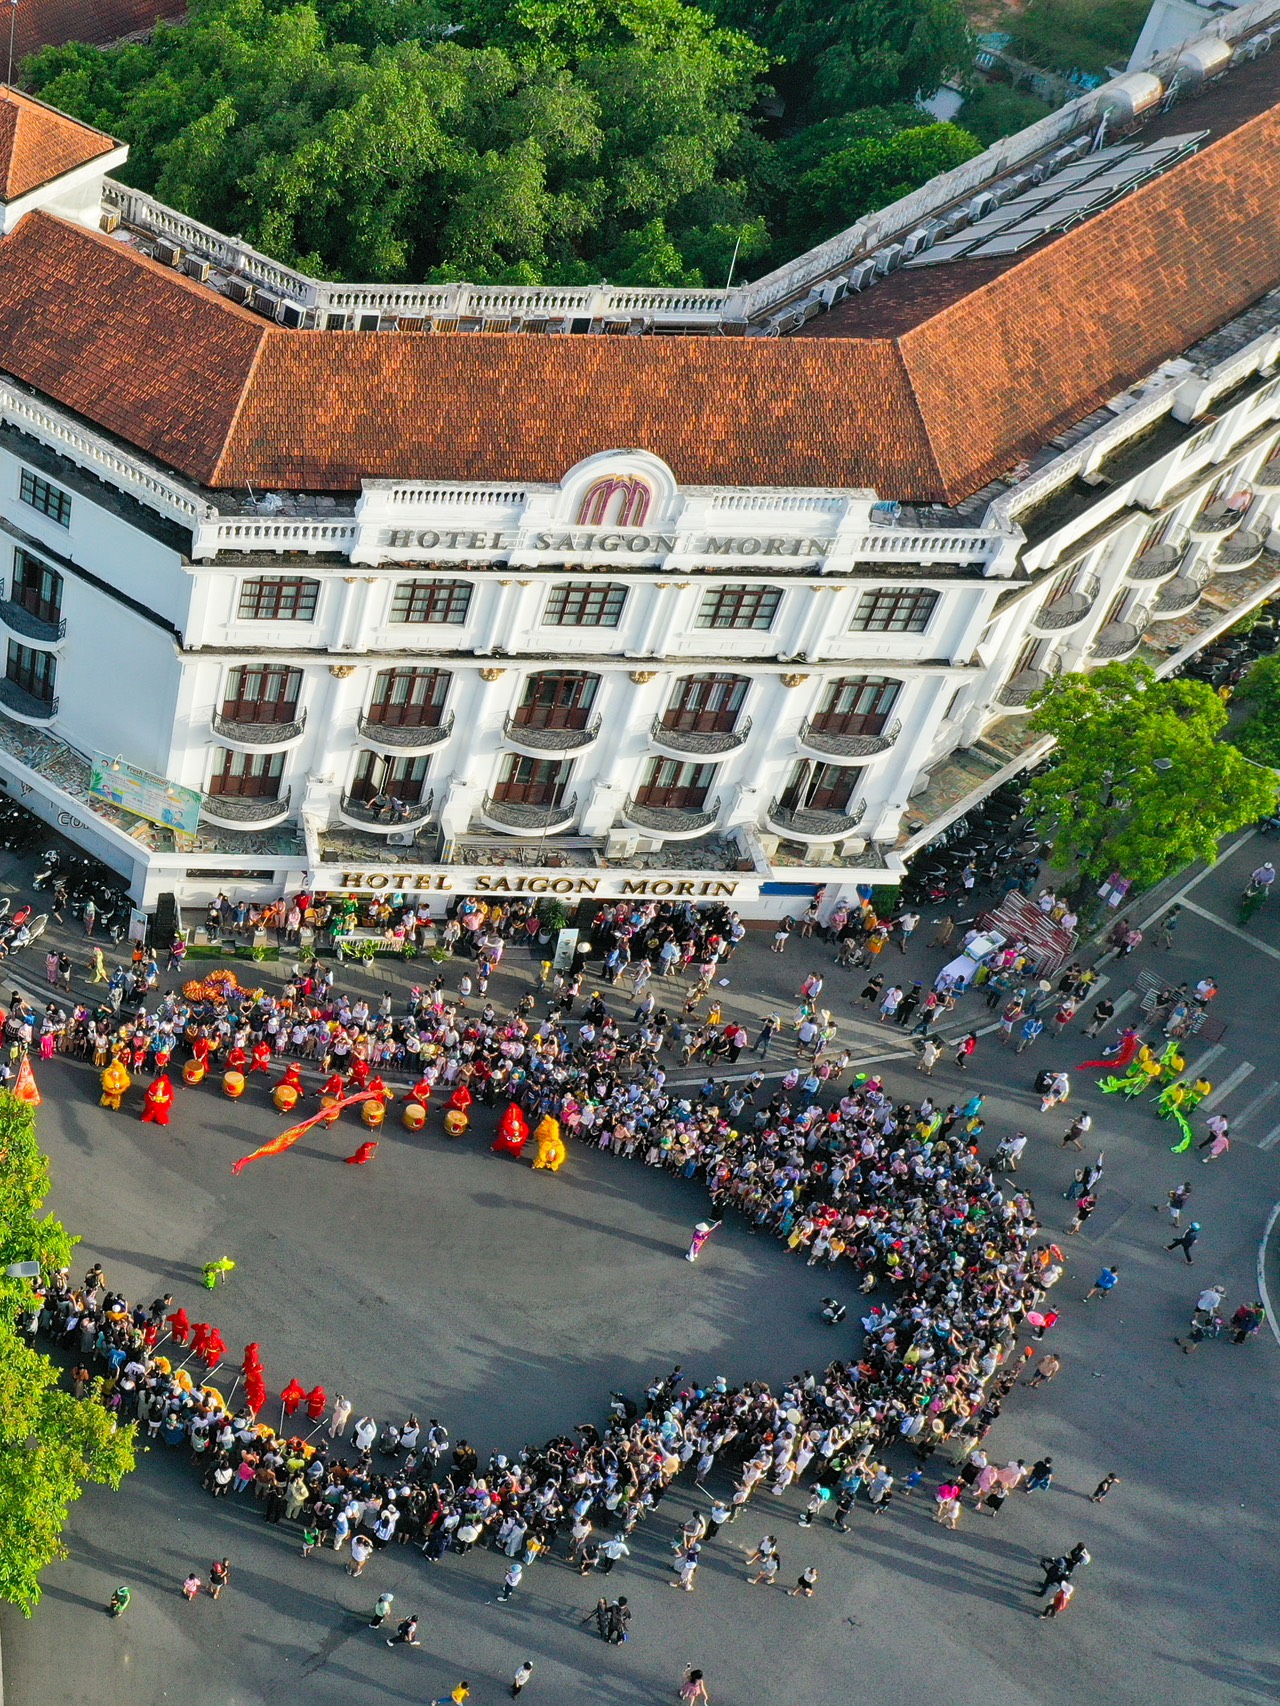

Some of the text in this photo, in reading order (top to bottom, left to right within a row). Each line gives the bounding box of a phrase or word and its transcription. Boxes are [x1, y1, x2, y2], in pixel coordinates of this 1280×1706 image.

[388, 529, 831, 556] HOTEL SAIGON MORIN
[57, 811, 90, 830] CO
[340, 872, 740, 897] HOTEL SAIGON MORIN
